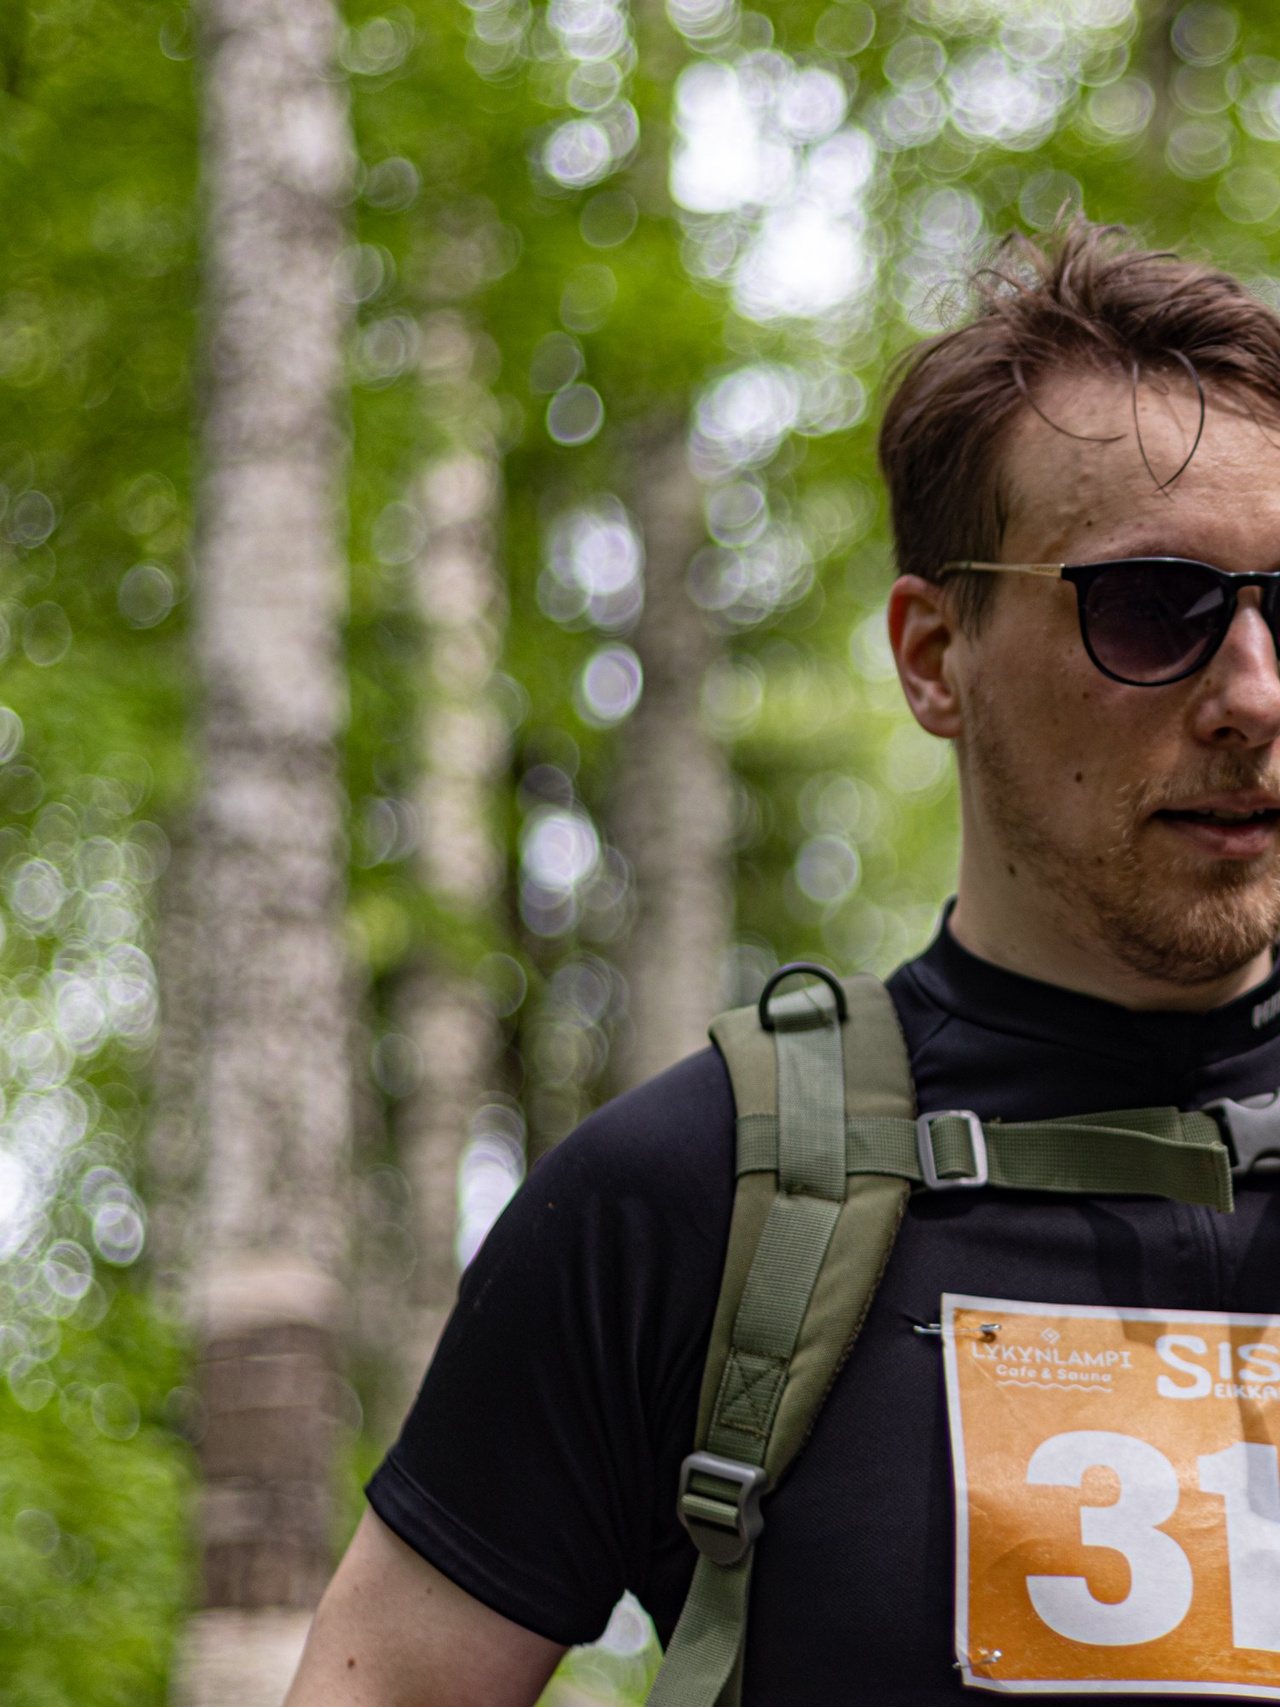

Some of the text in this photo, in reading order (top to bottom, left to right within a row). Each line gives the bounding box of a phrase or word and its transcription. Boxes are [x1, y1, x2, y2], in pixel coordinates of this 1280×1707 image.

[971, 1341, 1133, 1369] LYKYNLAMPI
[996, 1364, 1113, 1383] Cafe & Sauna
